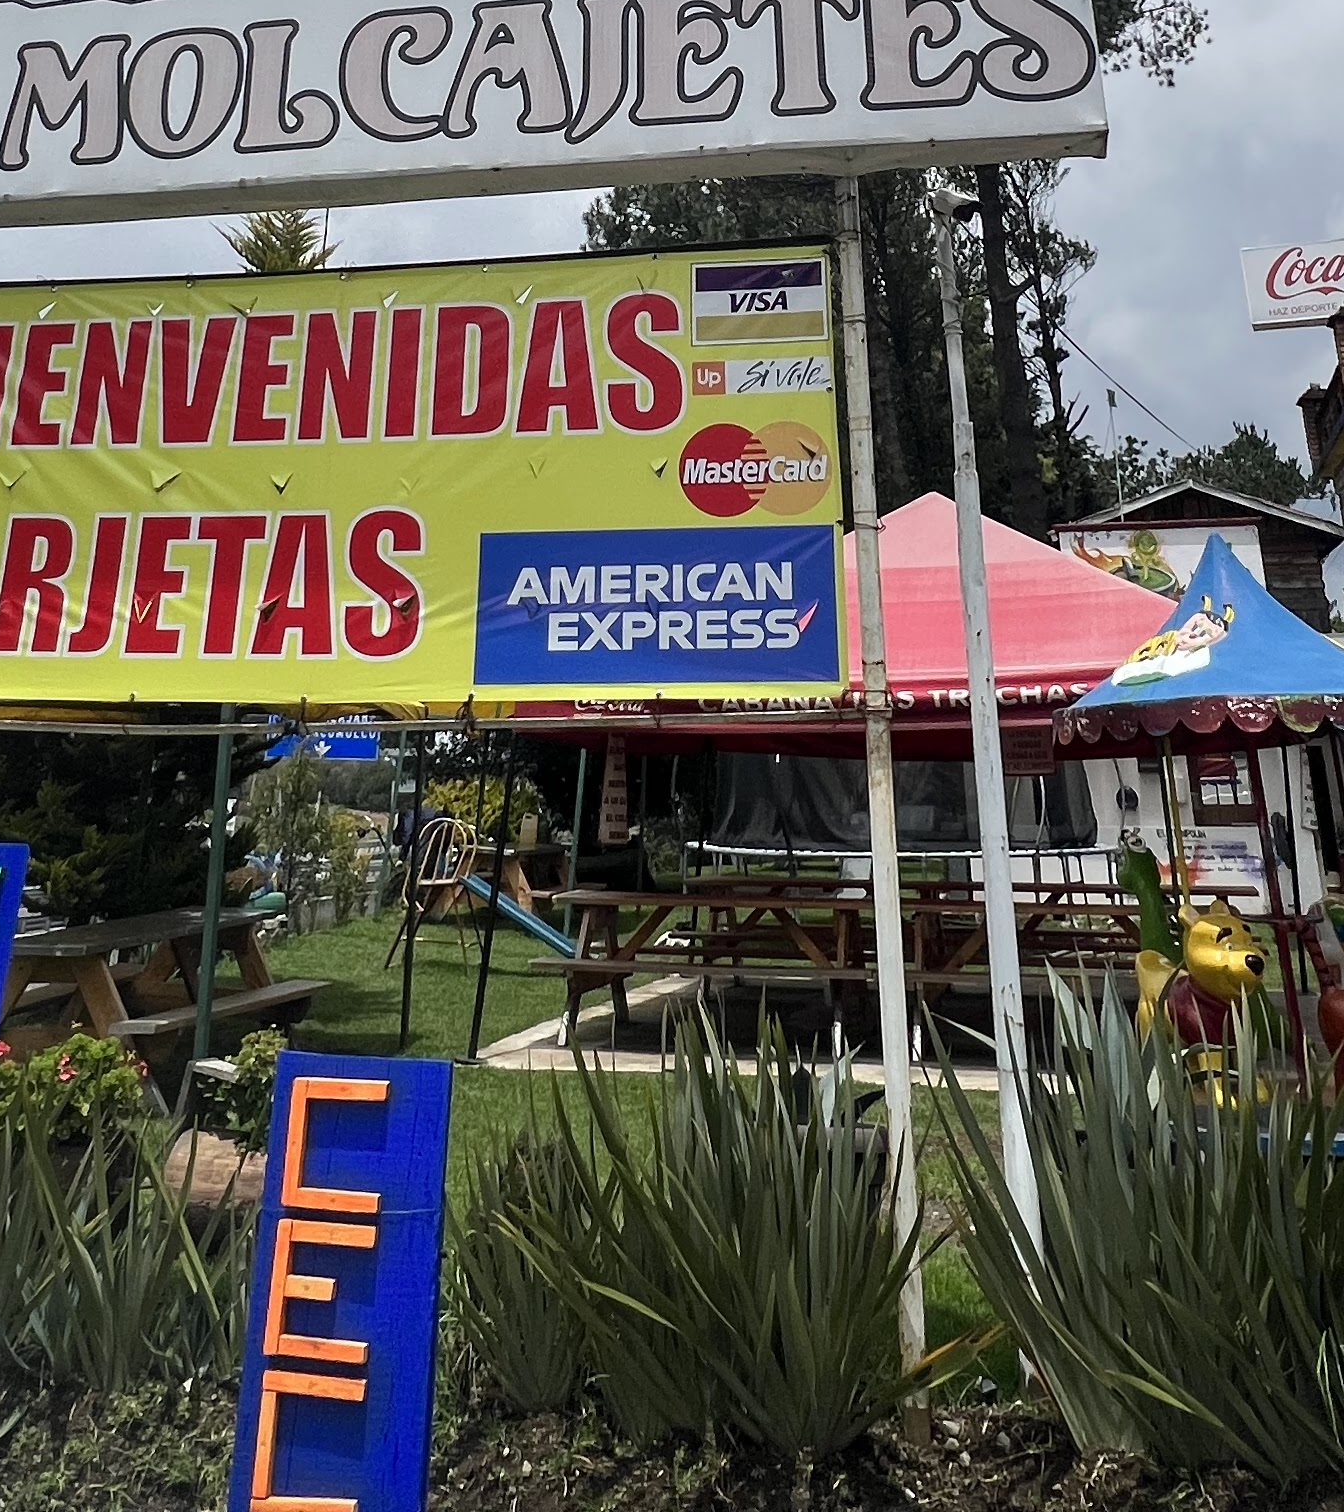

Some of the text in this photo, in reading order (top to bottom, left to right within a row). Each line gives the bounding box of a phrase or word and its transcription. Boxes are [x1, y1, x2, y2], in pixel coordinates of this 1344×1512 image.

[728, 290, 789, 314] VISA
[1268, 302, 1339, 317] HAZ DEPORTE
[697, 368, 722, 387] Up
[682, 455, 828, 485] MasterCard
[506, 561, 793, 606] AMERICAN
[546, 608, 801, 652] EXPRESS
[927, 683, 1089, 709] TRCHAS
